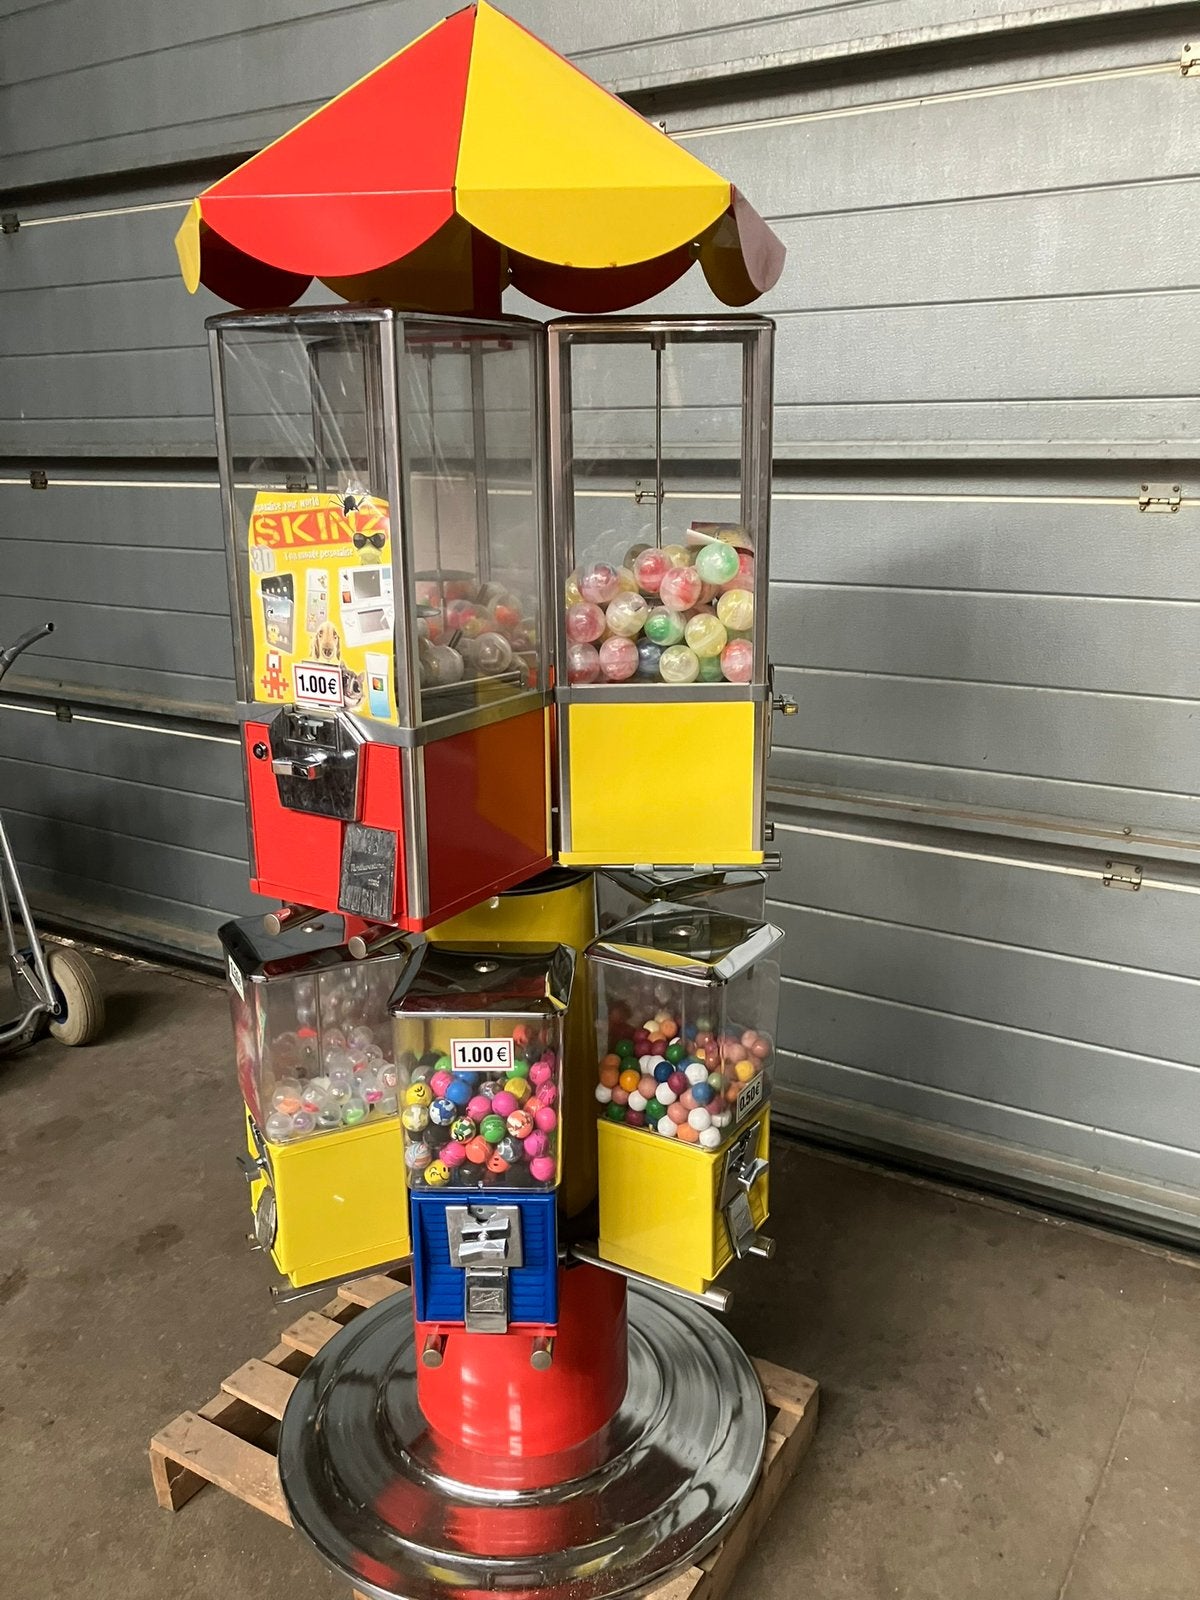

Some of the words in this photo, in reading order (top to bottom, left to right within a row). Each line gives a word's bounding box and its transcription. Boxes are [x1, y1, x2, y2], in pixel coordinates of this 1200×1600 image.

[300, 495, 320, 508] world
[254, 505, 387, 545] SKINZ
[251, 545, 275, 574] 3D
[298, 674, 337, 695] 1.00€
[458, 1046, 508, 1063] 1.00€
[740, 1081, 761, 1111] 0.50€
